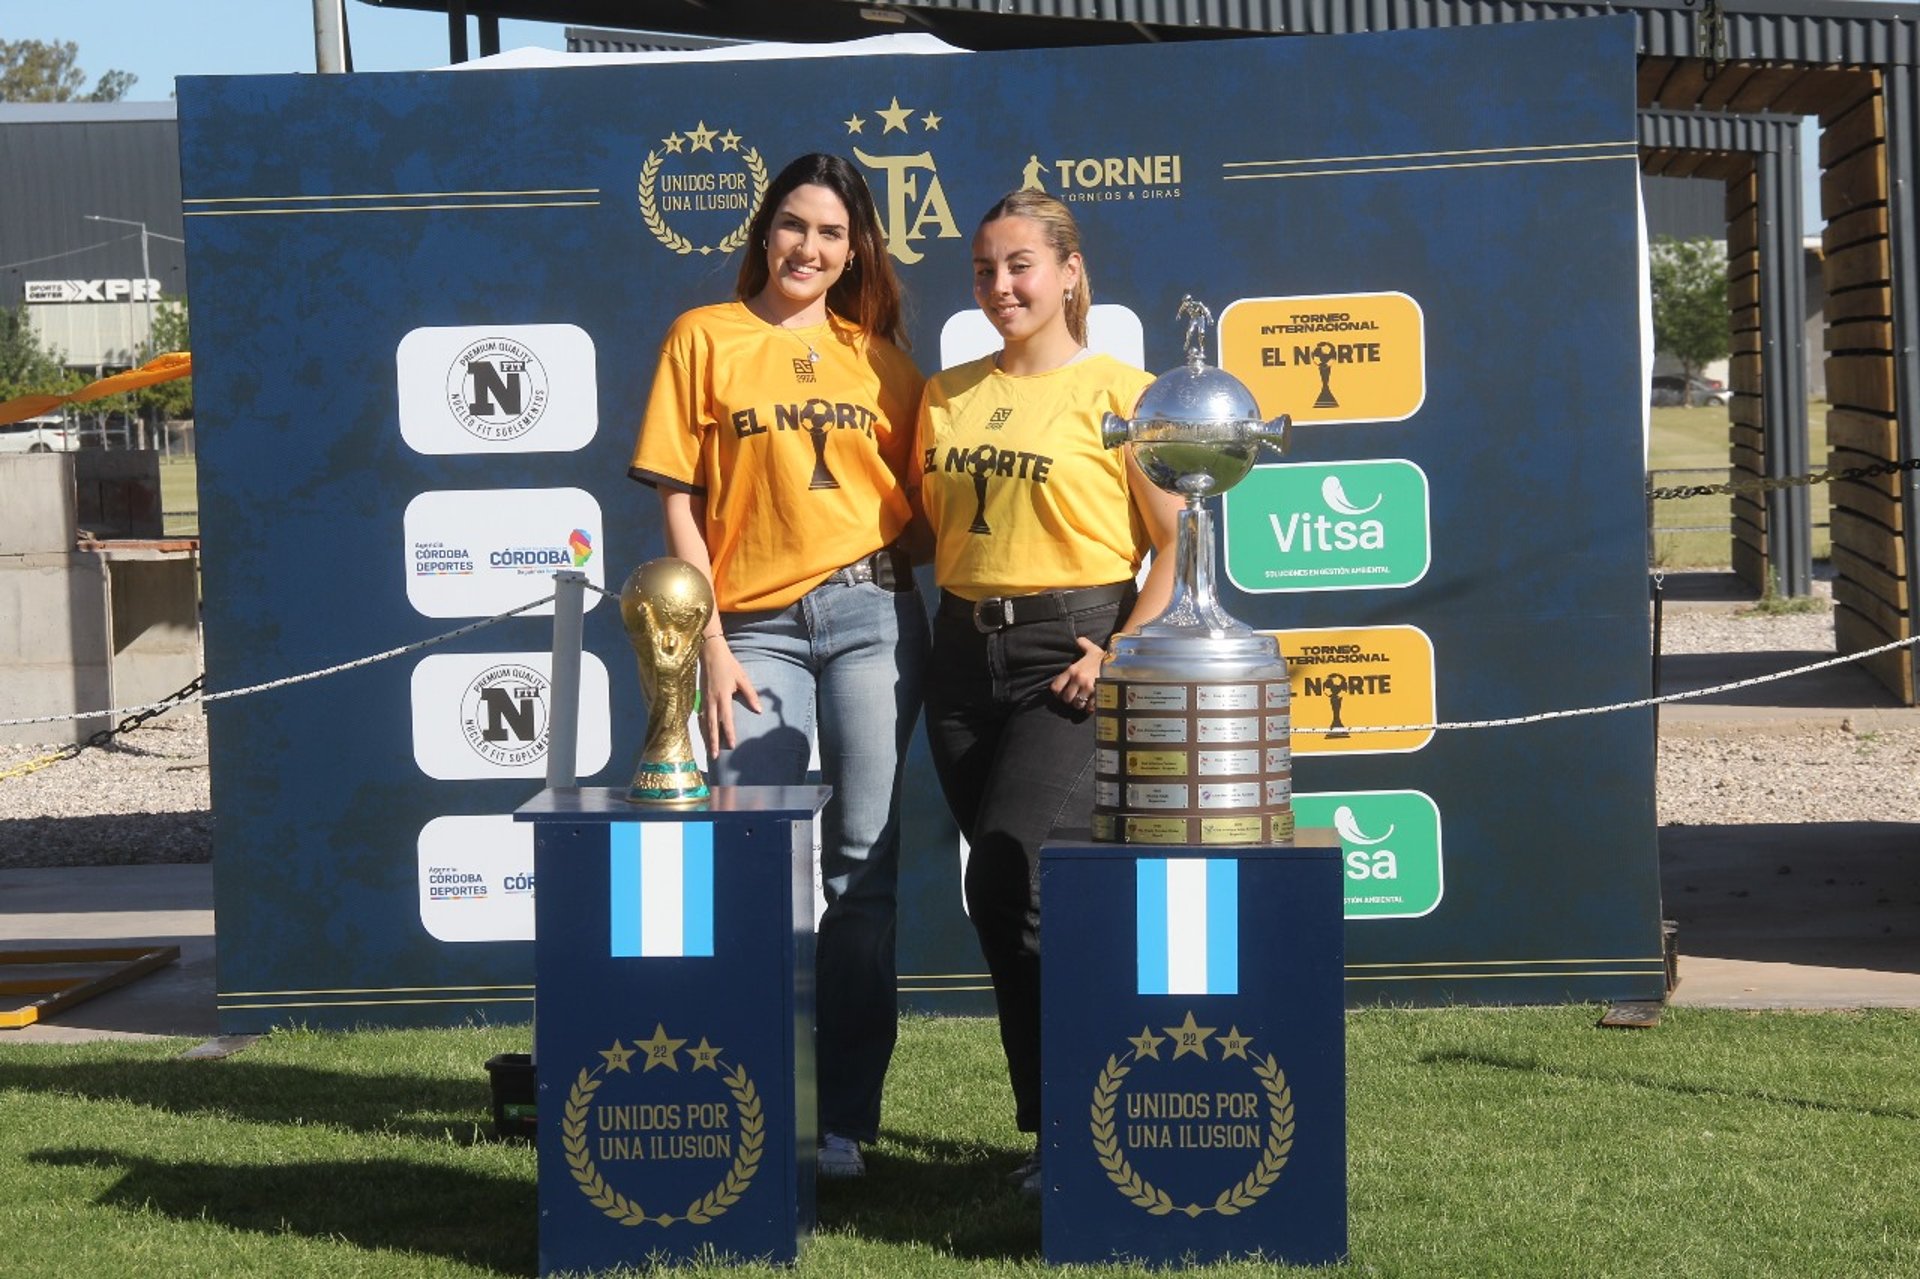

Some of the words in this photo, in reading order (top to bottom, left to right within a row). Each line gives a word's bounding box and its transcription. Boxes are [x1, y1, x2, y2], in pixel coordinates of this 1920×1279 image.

[661, 174, 715, 192] UNIDOS
[719, 173, 747, 191] POR
[1055, 155, 1182, 189] TORNEI
[662, 195, 693, 211] UNA
[695, 193, 749, 211] ILUSION
[1060, 192, 1122, 202] TORNEOS
[1127, 191, 1136, 200] &
[1142, 188, 1182, 199] GIRAS
[72, 279, 162, 302] XPR
[1261, 320, 1380, 336] INTERNACIONAL
[1289, 312, 1351, 325] TORNEO
[459, 342, 497, 367] PREMIUM
[499, 342, 534, 364] QUALITY
[1261, 347, 1287, 367] EL
[1293, 341, 1382, 367] NORTE
[501, 362, 523, 372] FIT
[467, 360, 522, 416] N
[476, 423, 492, 436] FIT
[732, 408, 768, 440] EL
[1268, 512, 1385, 553] Vitsa
[416, 561, 473, 572] DEPORTES
[489, 548, 571, 566] CÓRDOBA
[1285, 653, 1390, 665] TERNACIONAL
[1301, 645, 1361, 656] TORNEO
[473, 669, 511, 693] PREMIUM
[512, 669, 547, 691] QUALITY
[1304, 674, 1392, 697] NORTE
[481, 687, 536, 742] N
[430, 885, 488, 896] DEPORTES
[1183, 1032, 1198, 1046] 22
[653, 1045, 668, 1058] 22
[1126, 1093, 1210, 1119] UNIDOS
[1216, 1093, 1259, 1118] POR
[598, 1105, 681, 1131] UNIDOS
[687, 1103, 729, 1129] POR
[599, 1137, 645, 1160] UNA
[650, 1134, 731, 1159] ILUSION
[1128, 1125, 1173, 1148] UNA
[1179, 1125, 1261, 1148] ILUSION
